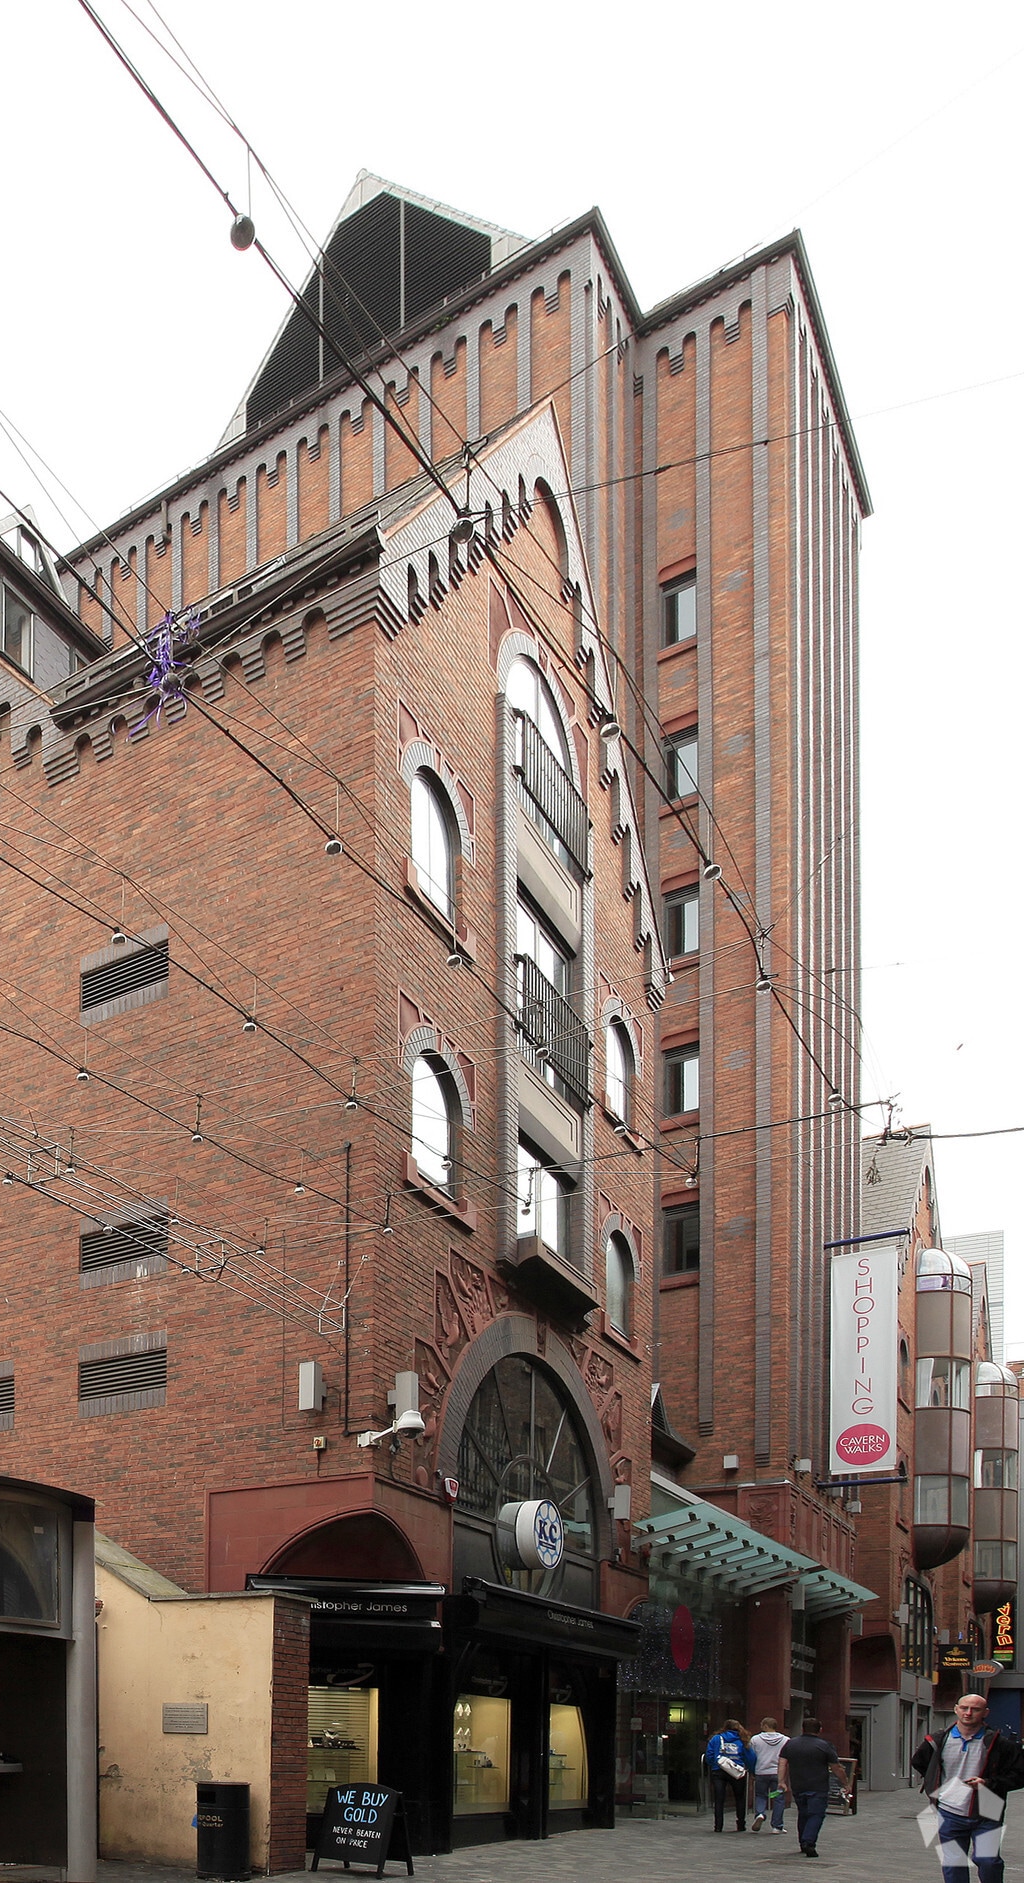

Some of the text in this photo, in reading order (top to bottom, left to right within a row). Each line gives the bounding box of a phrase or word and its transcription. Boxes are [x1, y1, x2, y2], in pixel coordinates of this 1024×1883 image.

[852, 1258, 875, 1415] SHOPPING
[839, 1434, 885, 1447] CAVERN
[844, 1443, 883, 1454] WALKS
[537, 1520, 558, 1543] KC
[366, 1602, 408, 1612] James
[337, 1790, 389, 1806] WE BUY
[344, 1807, 377, 1823] GOLD
[332, 1826, 381, 1839] NEVER BEATEN
[336, 1837, 368, 1849] ON PRICE
